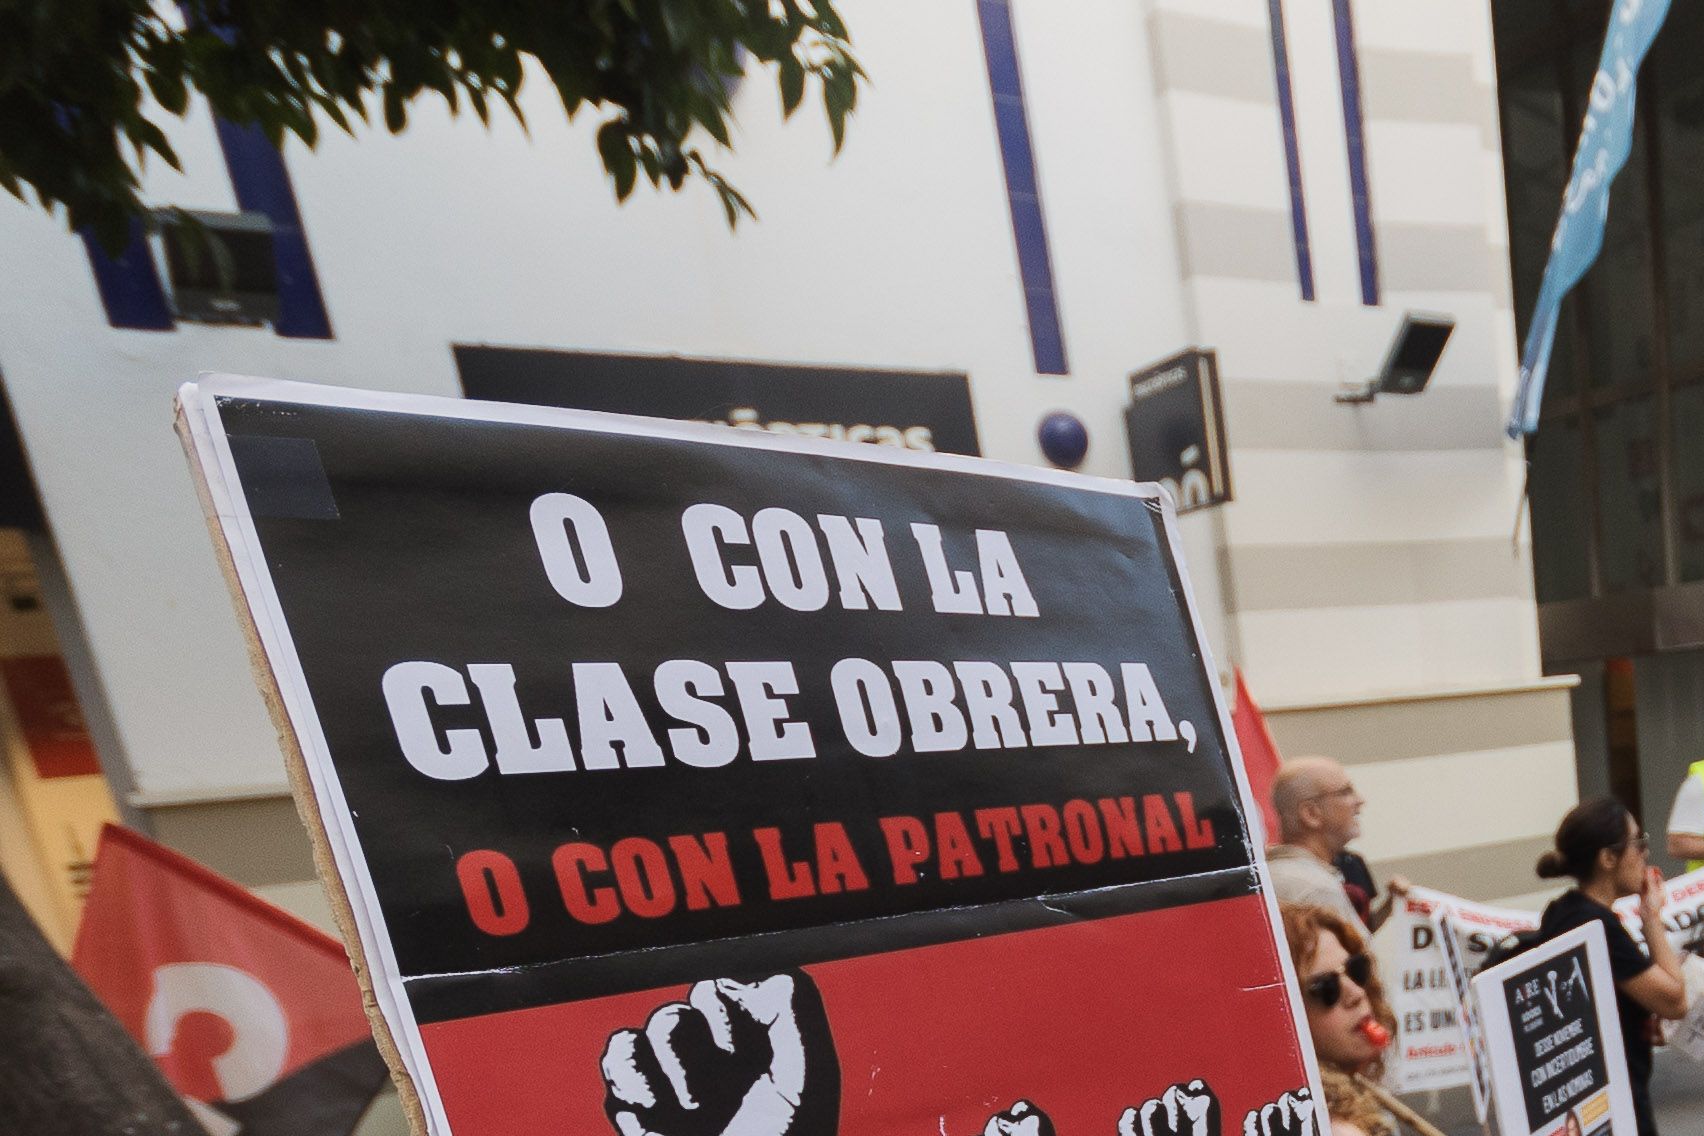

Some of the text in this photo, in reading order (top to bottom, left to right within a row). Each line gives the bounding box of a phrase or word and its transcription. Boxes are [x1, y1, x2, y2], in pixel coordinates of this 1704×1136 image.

[530, 491, 1040, 618] O CON LA
[382, 656, 1198, 781] CLASE OBRERA,
[456, 790, 1217, 937] O CON LA PATRONAL
